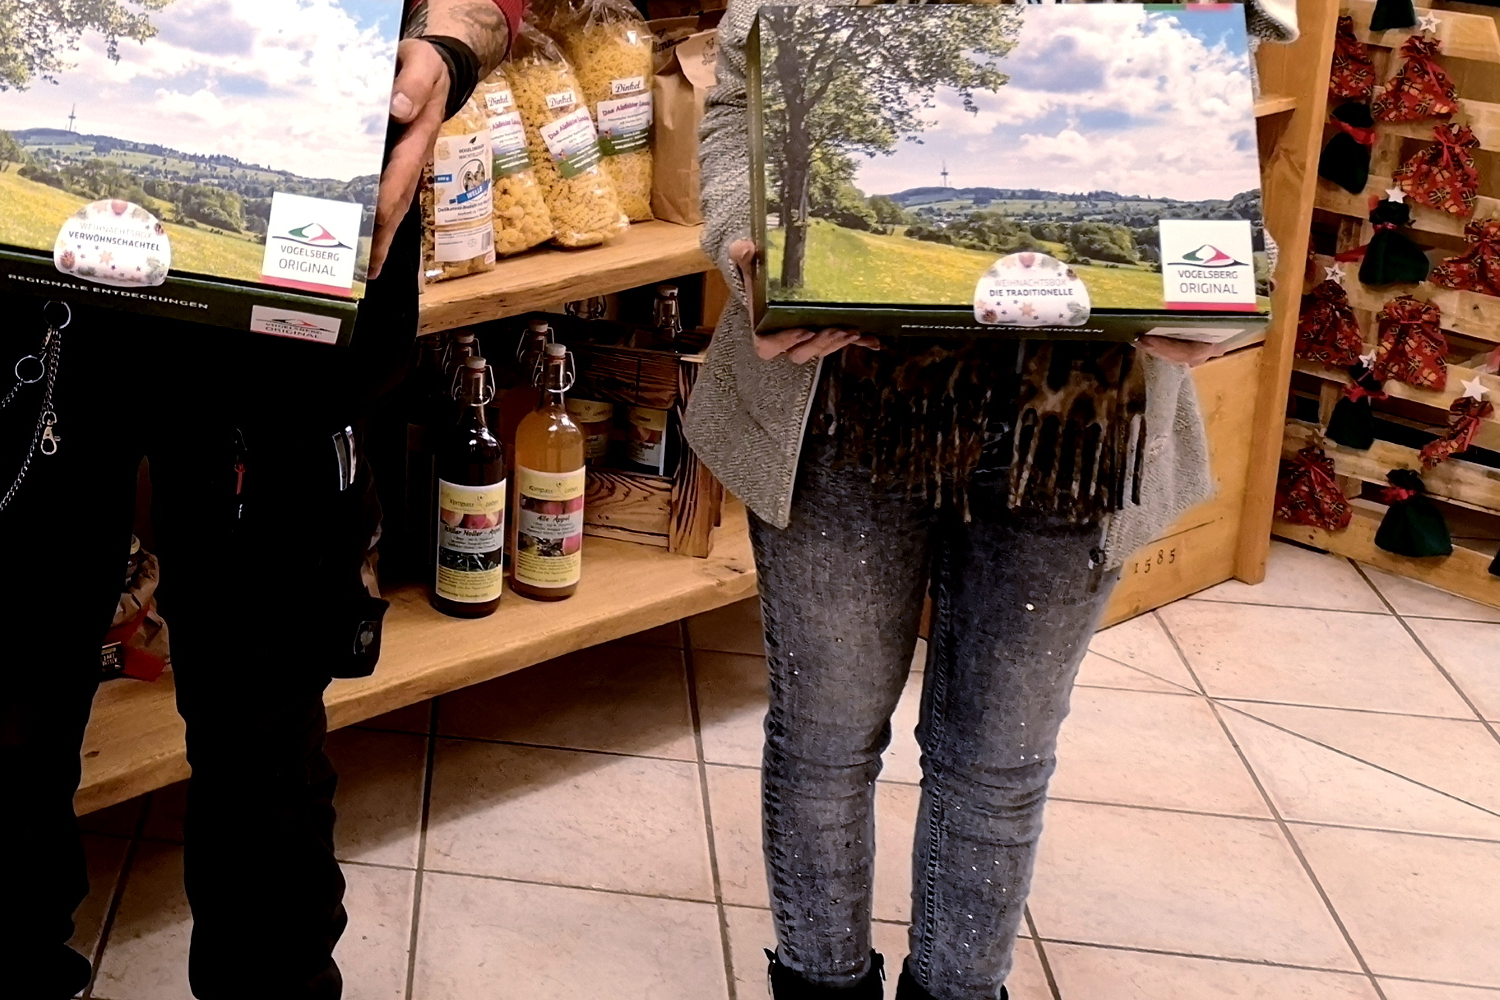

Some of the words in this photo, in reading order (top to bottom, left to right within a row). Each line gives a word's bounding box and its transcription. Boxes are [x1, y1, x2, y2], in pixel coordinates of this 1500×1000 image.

[615, 80, 641, 94] Dinkel
[466, 186, 483, 199] WELLE
[79, 221, 153, 240] WEIHNACHTSBOX
[68, 230, 161, 252] VERWÖHNSCHACHTEL
[280, 244, 340, 262] VOGELSBERG
[278, 258, 336, 277] ORIGINAL
[1178, 269, 1239, 280] VOGELSBERG
[994, 278, 1067, 288] WEIHNACHTSBOX
[1179, 281, 1239, 295] ORIGINAL
[8, 273, 89, 292] REGIONALE
[92, 286, 209, 310] ENTDECKUNGEN
[989, 289, 1004, 297] DIE
[1006, 288, 1074, 297] TRADITIONELLE
[1133, 547, 1177, 575] 1585
